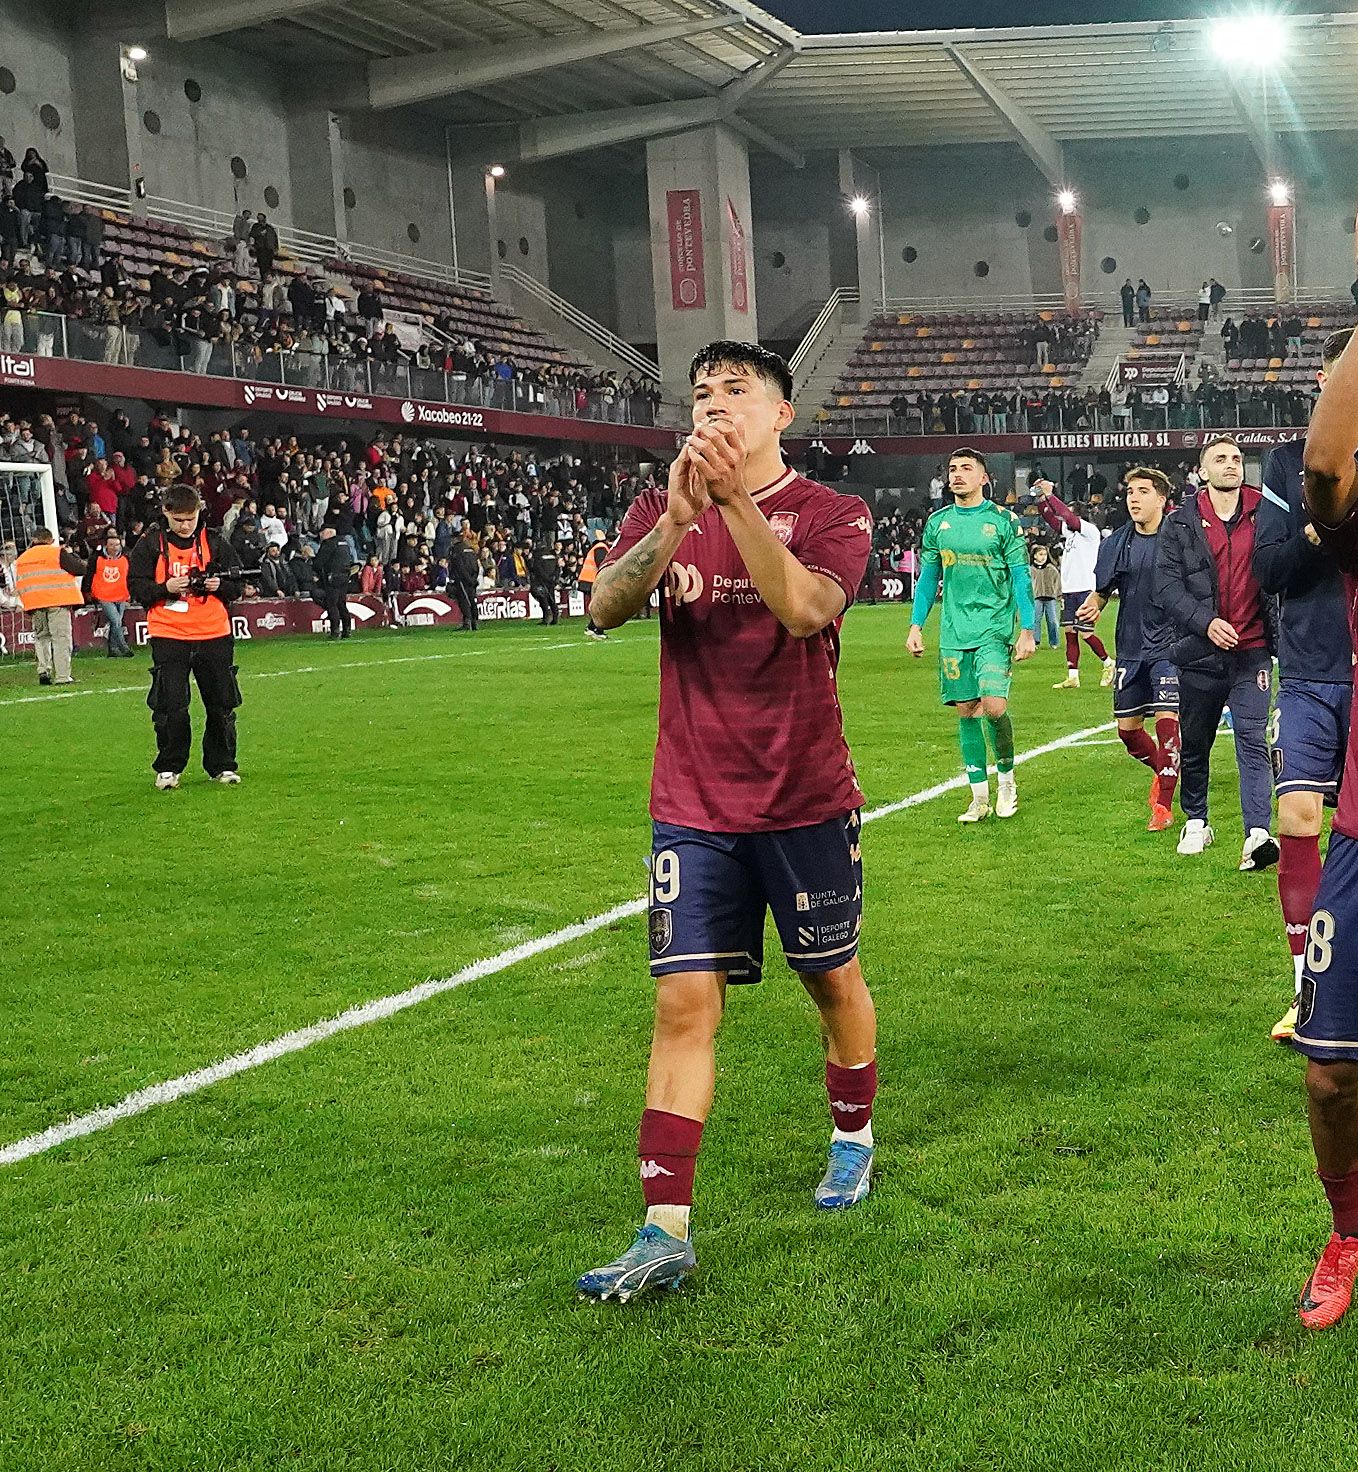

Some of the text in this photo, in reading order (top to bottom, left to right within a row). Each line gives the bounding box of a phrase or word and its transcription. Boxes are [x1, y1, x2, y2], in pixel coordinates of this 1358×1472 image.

[683, 198, 696, 271] PONTEVEDRA
[418, 405, 483, 427] Xacobeo 21-22
[1032, 434, 1090, 449] TALLERES
[1093, 433, 1152, 449] HEMICAR,
[1156, 432, 1170, 446] SL
[1236, 432, 1275, 445] Caldas,
[809, 890, 837, 899] XUNTA
[811, 894, 850, 909] DE GALICIA
[820, 920, 851, 935] DEPORTE
[821, 931, 849, 944] GALEGO
